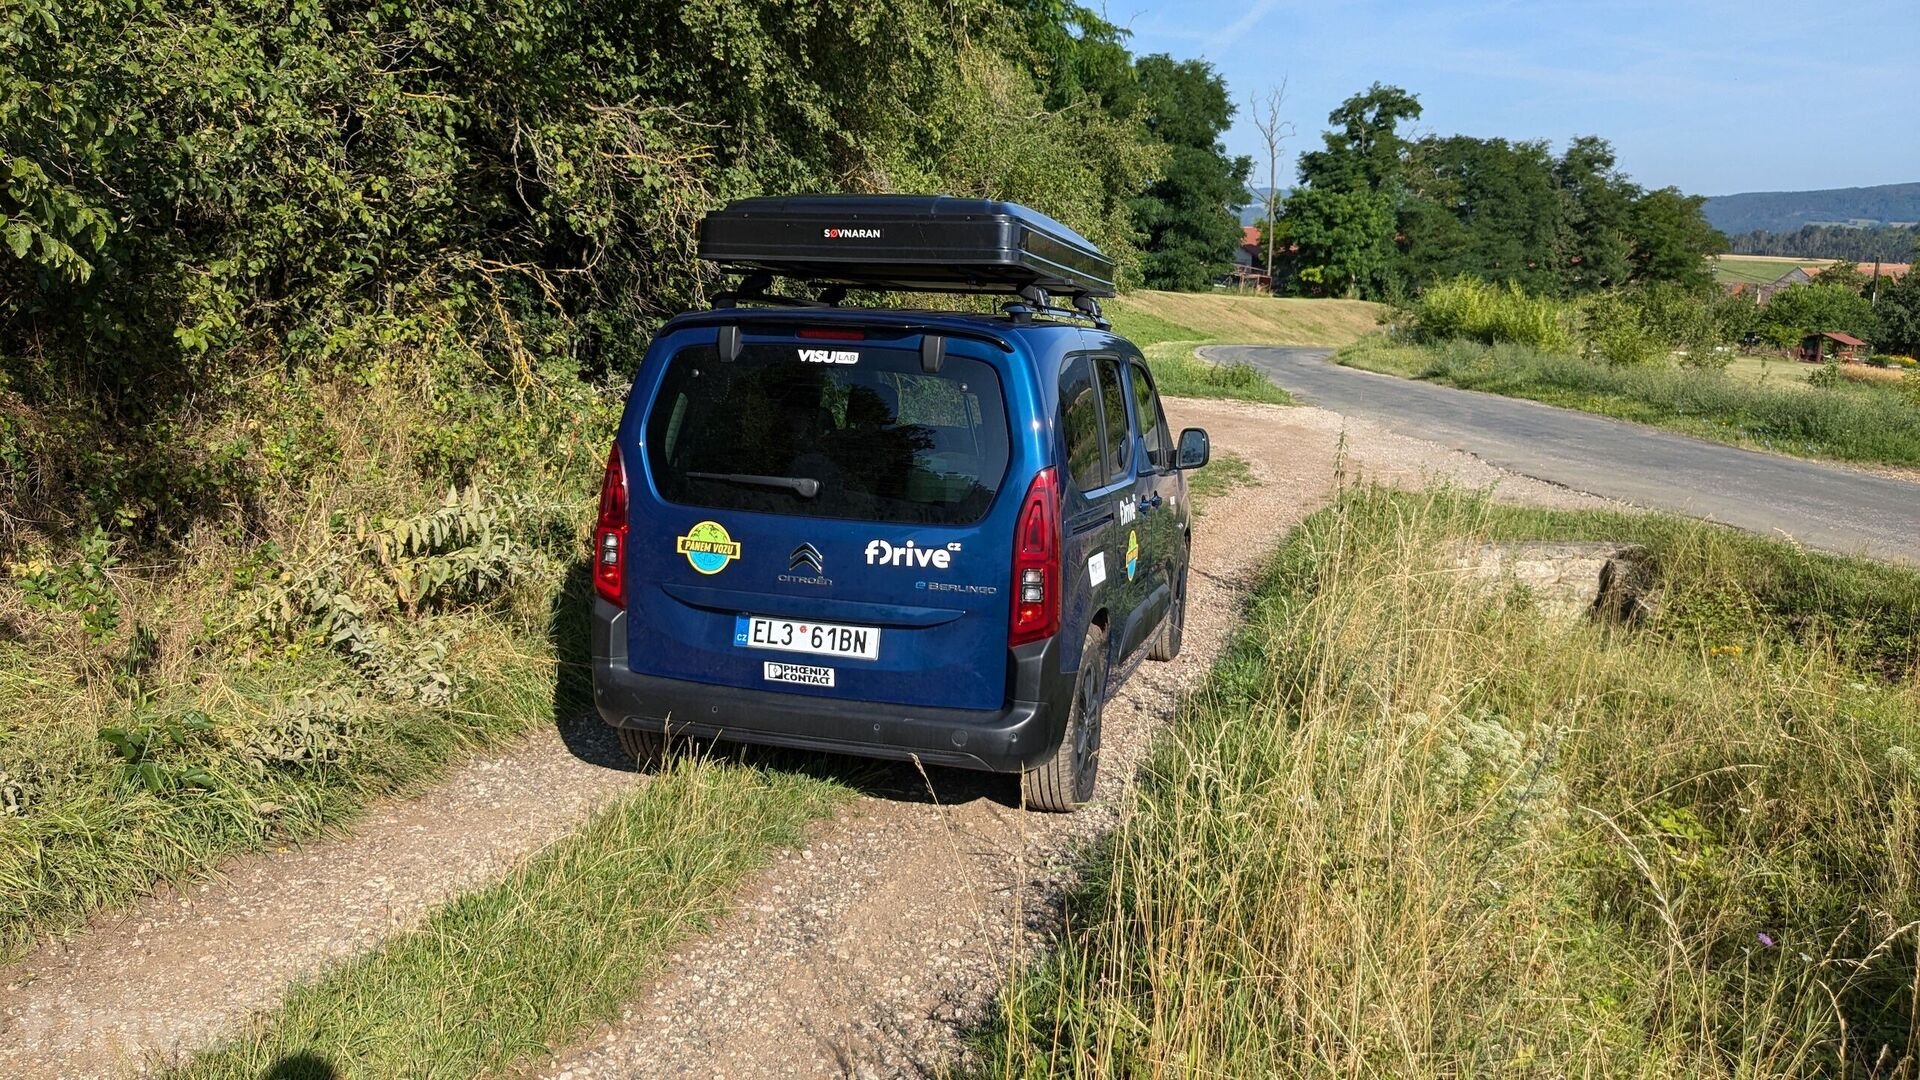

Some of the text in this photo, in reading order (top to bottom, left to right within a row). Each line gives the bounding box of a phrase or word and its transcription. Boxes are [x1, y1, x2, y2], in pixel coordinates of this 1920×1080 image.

[823, 228, 881, 238] SØVNARAN
[797, 349, 856, 364] VISU LAB
[713, 542, 734, 555] VOZU
[928, 582, 997, 595] BERLINGO
[736, 633, 748, 642] CZ
[753, 620, 868, 654] EL3 61BN
[783, 673, 831, 685] CONTACT
